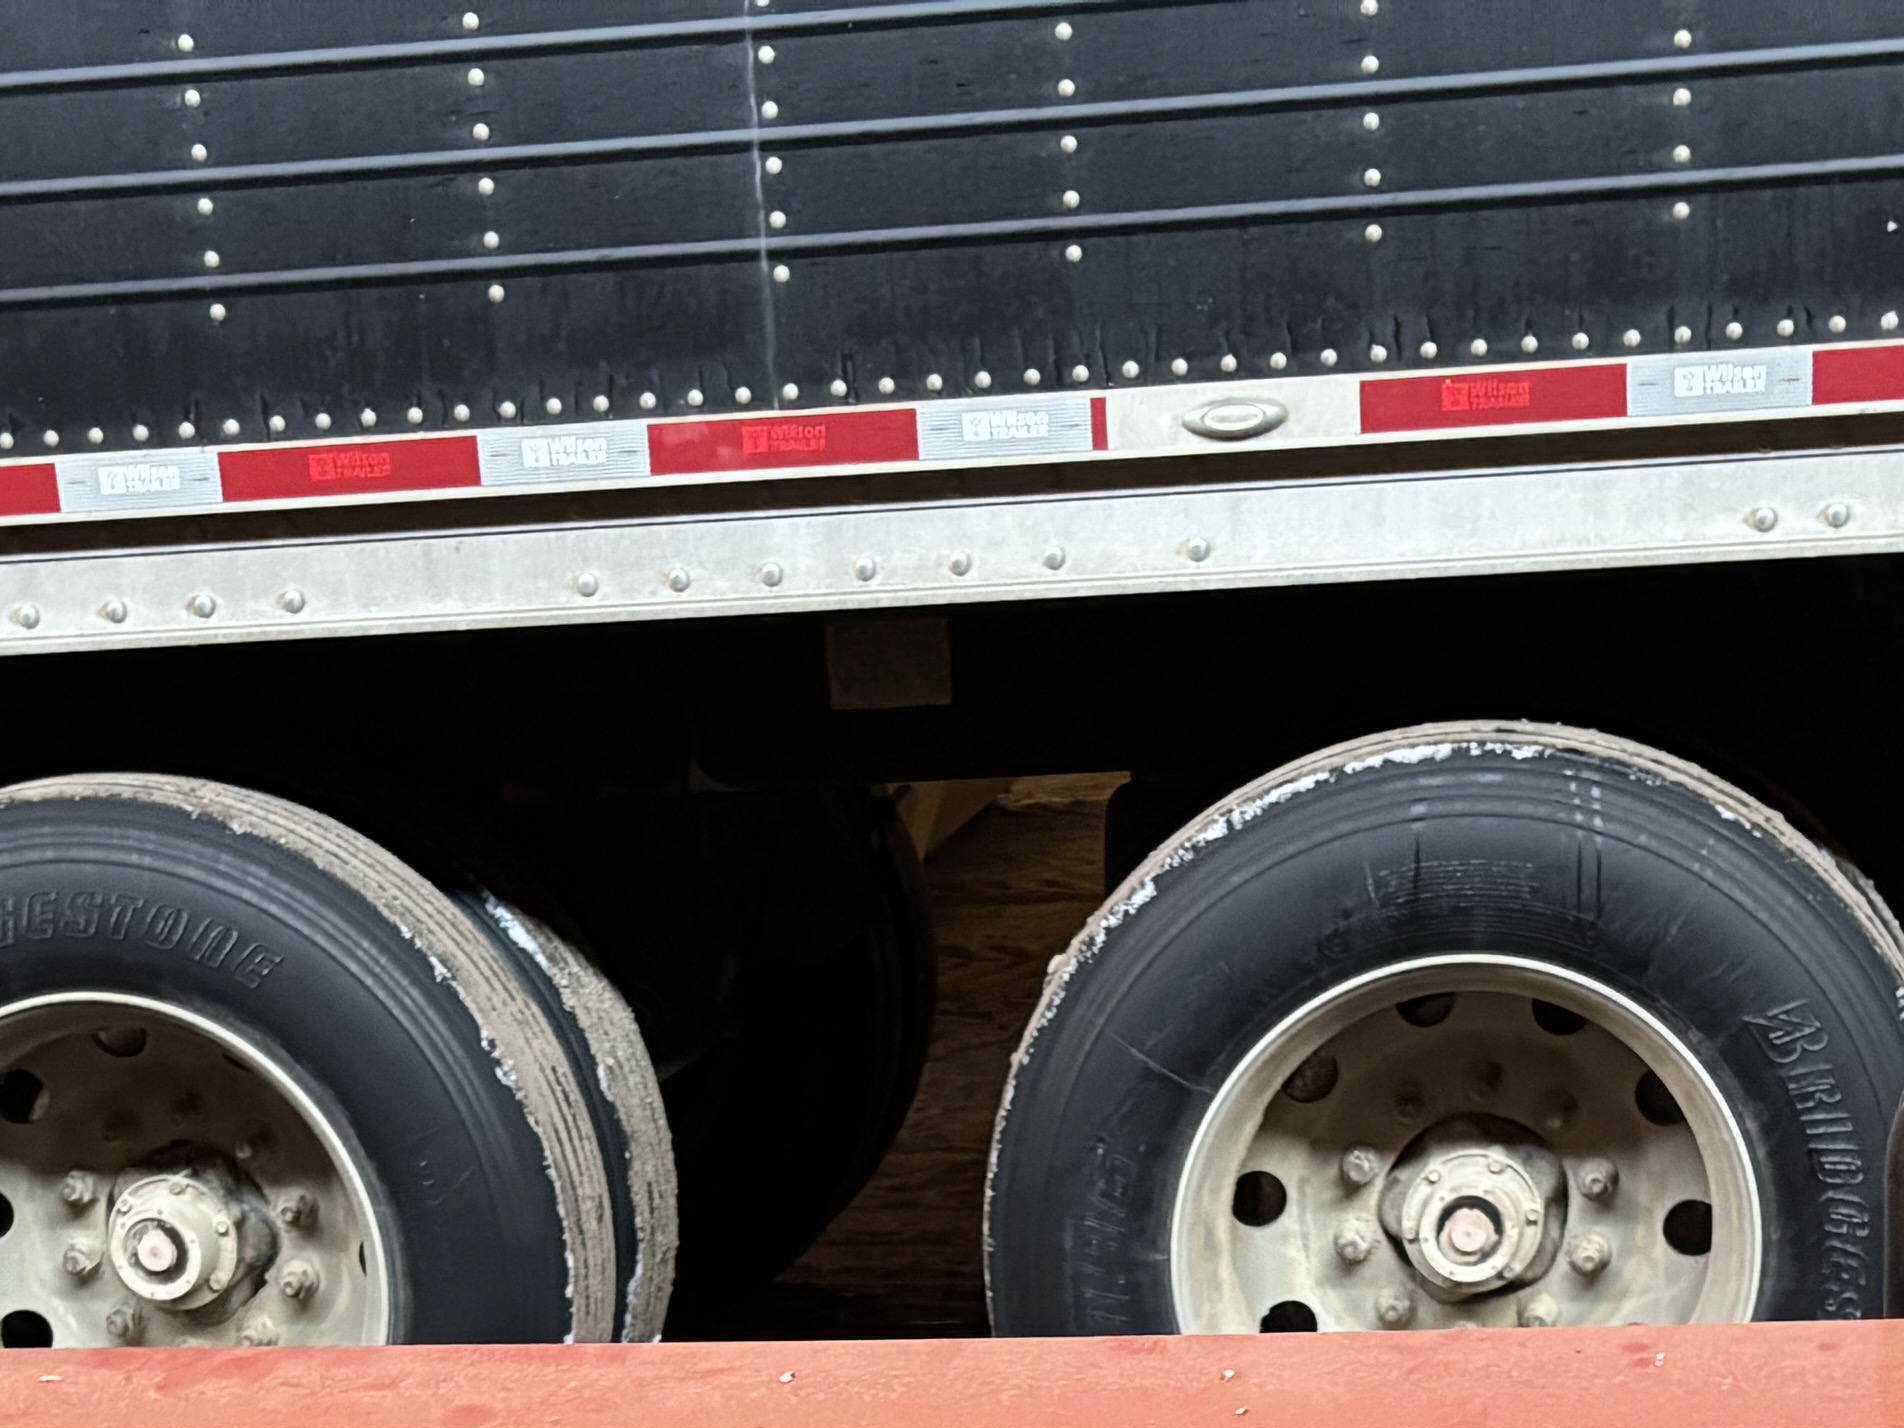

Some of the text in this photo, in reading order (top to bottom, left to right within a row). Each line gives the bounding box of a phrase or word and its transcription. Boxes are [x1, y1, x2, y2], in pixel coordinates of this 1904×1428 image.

[1704, 364, 1766, 381] Wilson
[1470, 380, 1530, 396] Wilson
[1704, 378, 1766, 394] TRAILER
[990, 410, 1048, 426] Wilson
[991, 424, 1048, 439] TRAILER
[549, 437, 606, 452] Wilson
[126, 464, 179, 479] Wilson
[1743, 1000, 1870, 1319] BRIDGES
